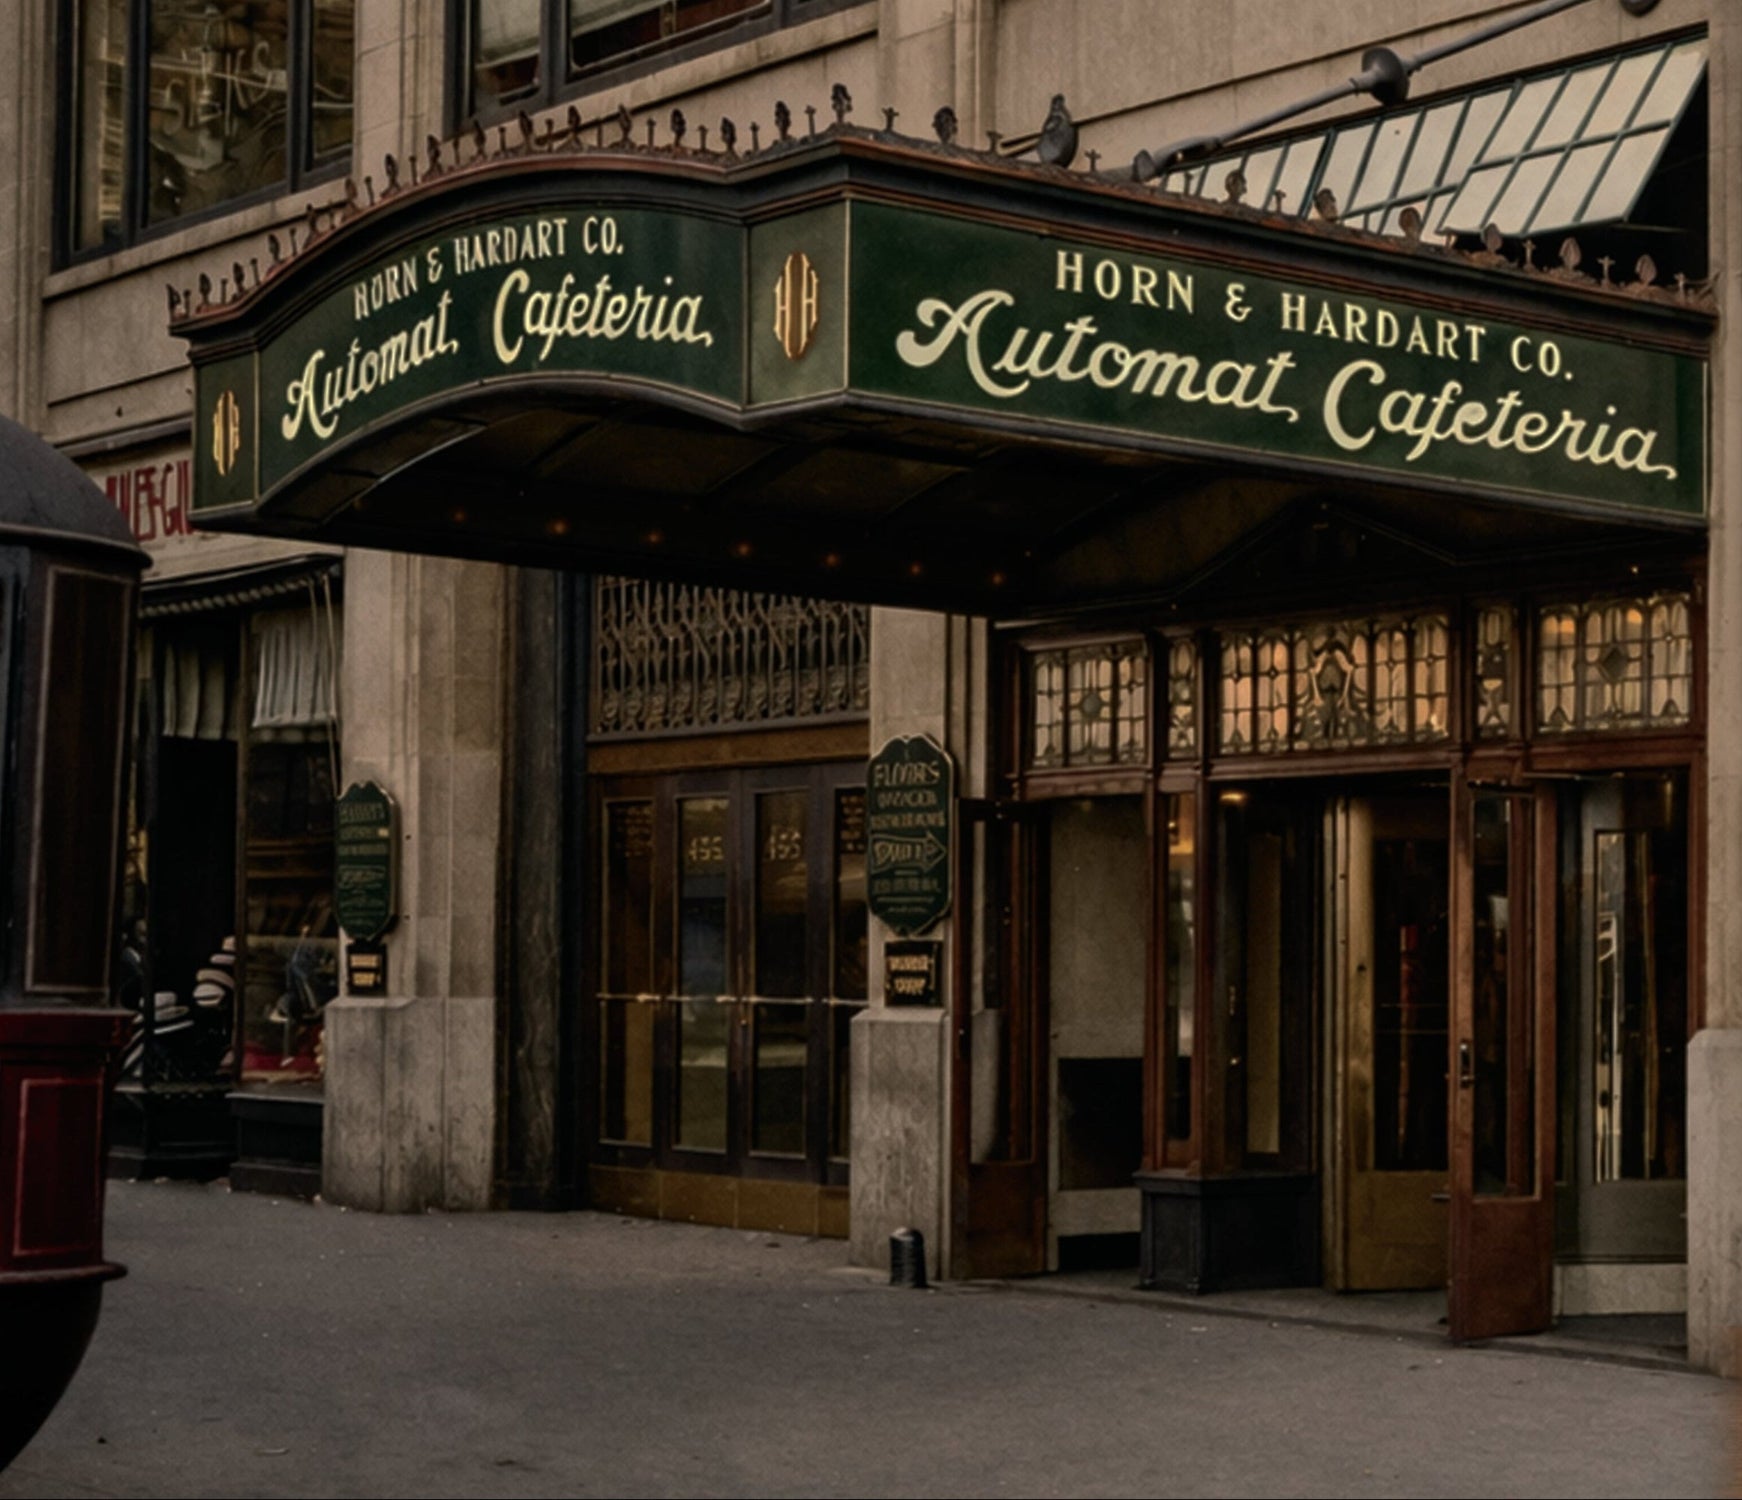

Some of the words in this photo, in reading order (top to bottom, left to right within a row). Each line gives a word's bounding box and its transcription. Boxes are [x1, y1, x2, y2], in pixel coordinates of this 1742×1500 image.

[354, 261, 417, 319] HORN
[427, 248, 443, 282] &
[455, 217, 568, 278] HARDART
[582, 216, 623, 257] CO.
[1055, 251, 1195, 315] HORN
[1224, 284, 1252, 322] &
[1280, 294, 1486, 363] HARDART
[1510, 336, 1573, 381] CO.
[282, 290, 458, 440] Automat
[493, 269, 714, 363] Cafeteria
[896, 289, 1300, 422] Automat
[1323, 359, 1677, 480] Cafeteria
